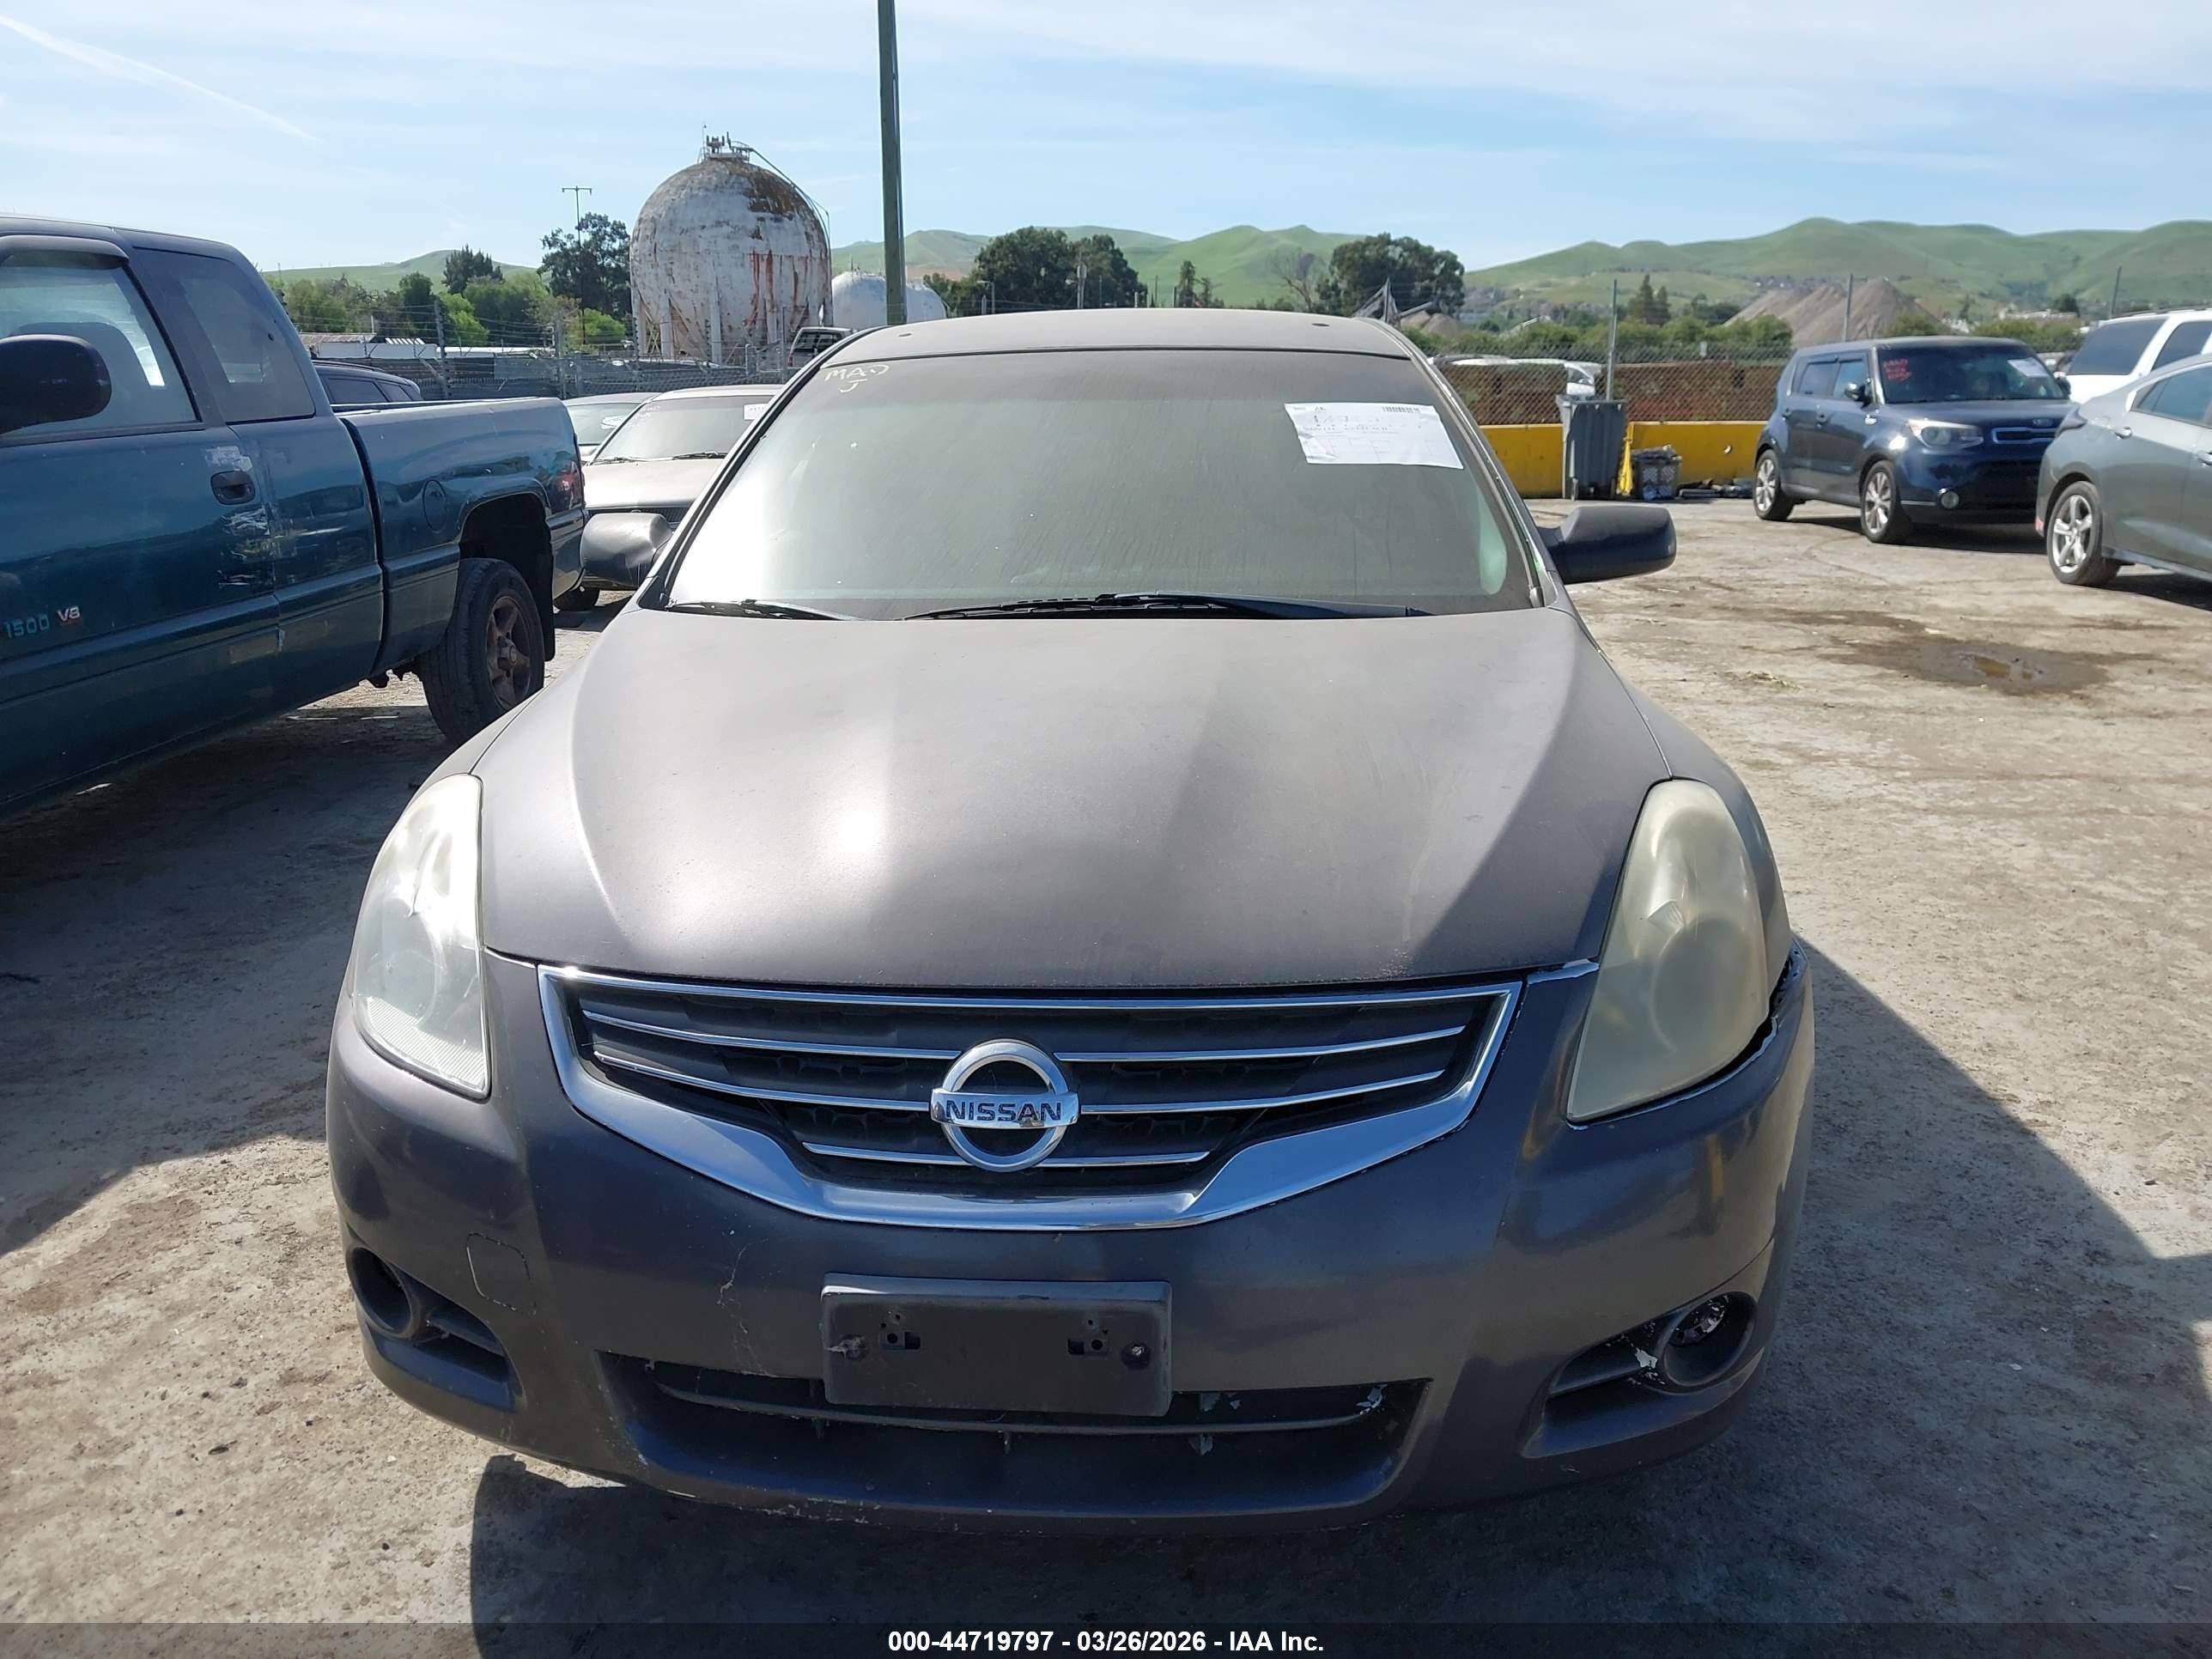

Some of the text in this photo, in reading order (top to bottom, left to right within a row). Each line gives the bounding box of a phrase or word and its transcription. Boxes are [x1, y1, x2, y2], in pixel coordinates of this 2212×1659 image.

[4, 605, 81, 639] 1500 V8
[945, 1100, 1061, 1121] NISSAN
